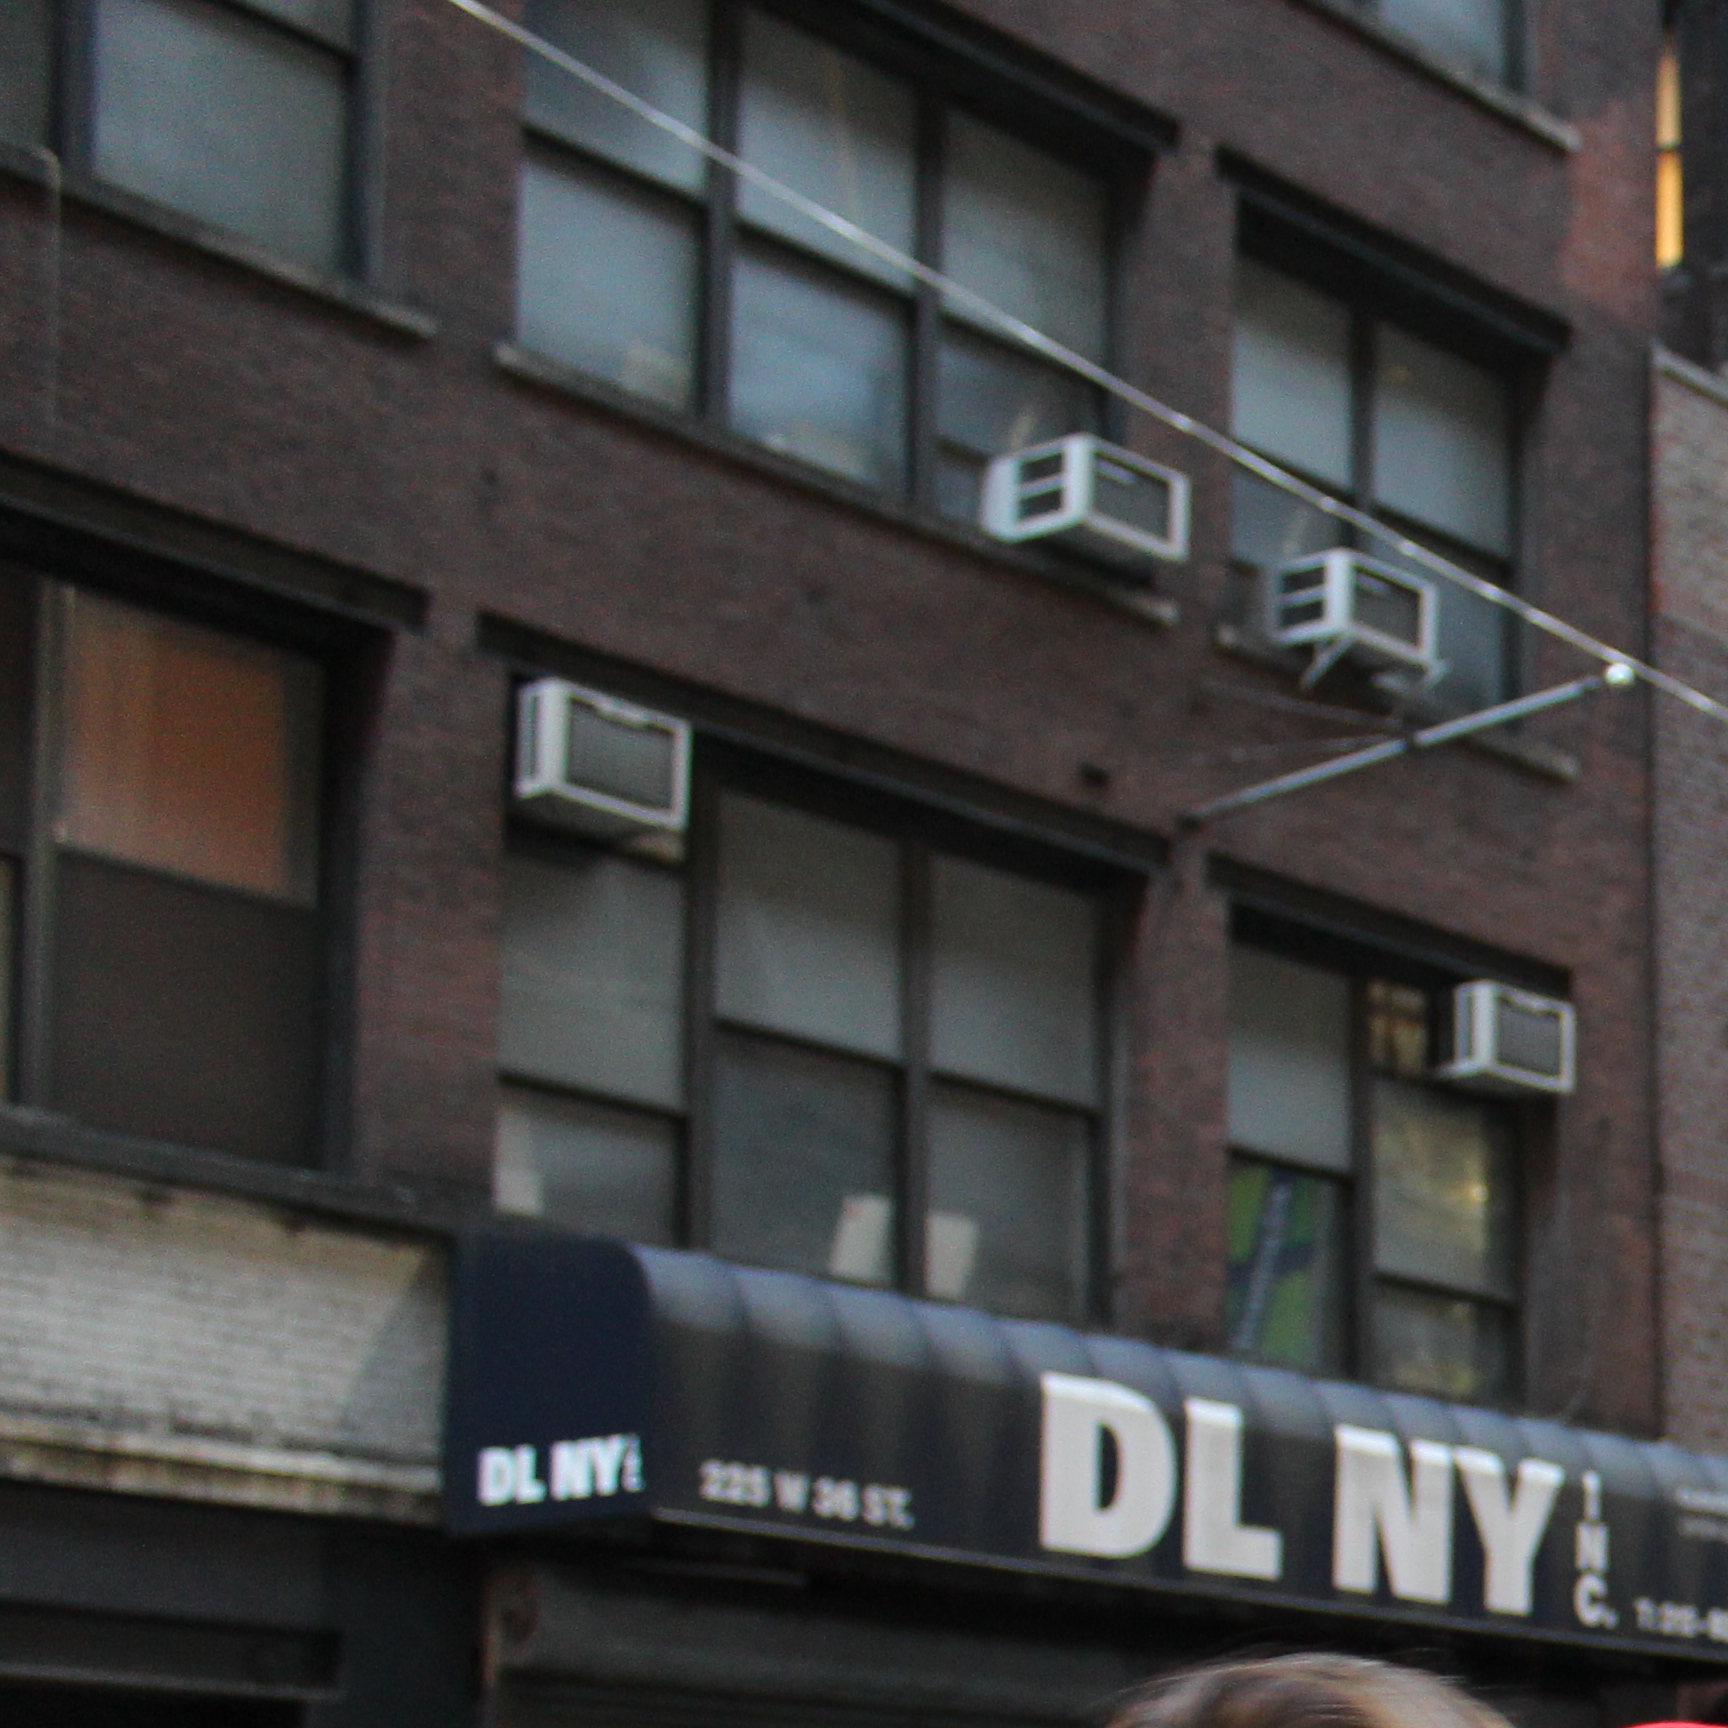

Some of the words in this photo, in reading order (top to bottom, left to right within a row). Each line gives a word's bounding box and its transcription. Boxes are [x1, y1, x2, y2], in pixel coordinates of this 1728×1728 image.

[478, 1445, 546, 1506] DL
[551, 1434, 627, 1500] NY
[773, 1471, 810, 1514] W
[1040, 1371, 1284, 1581] DL
[1331, 1423, 1566, 1616] NY
